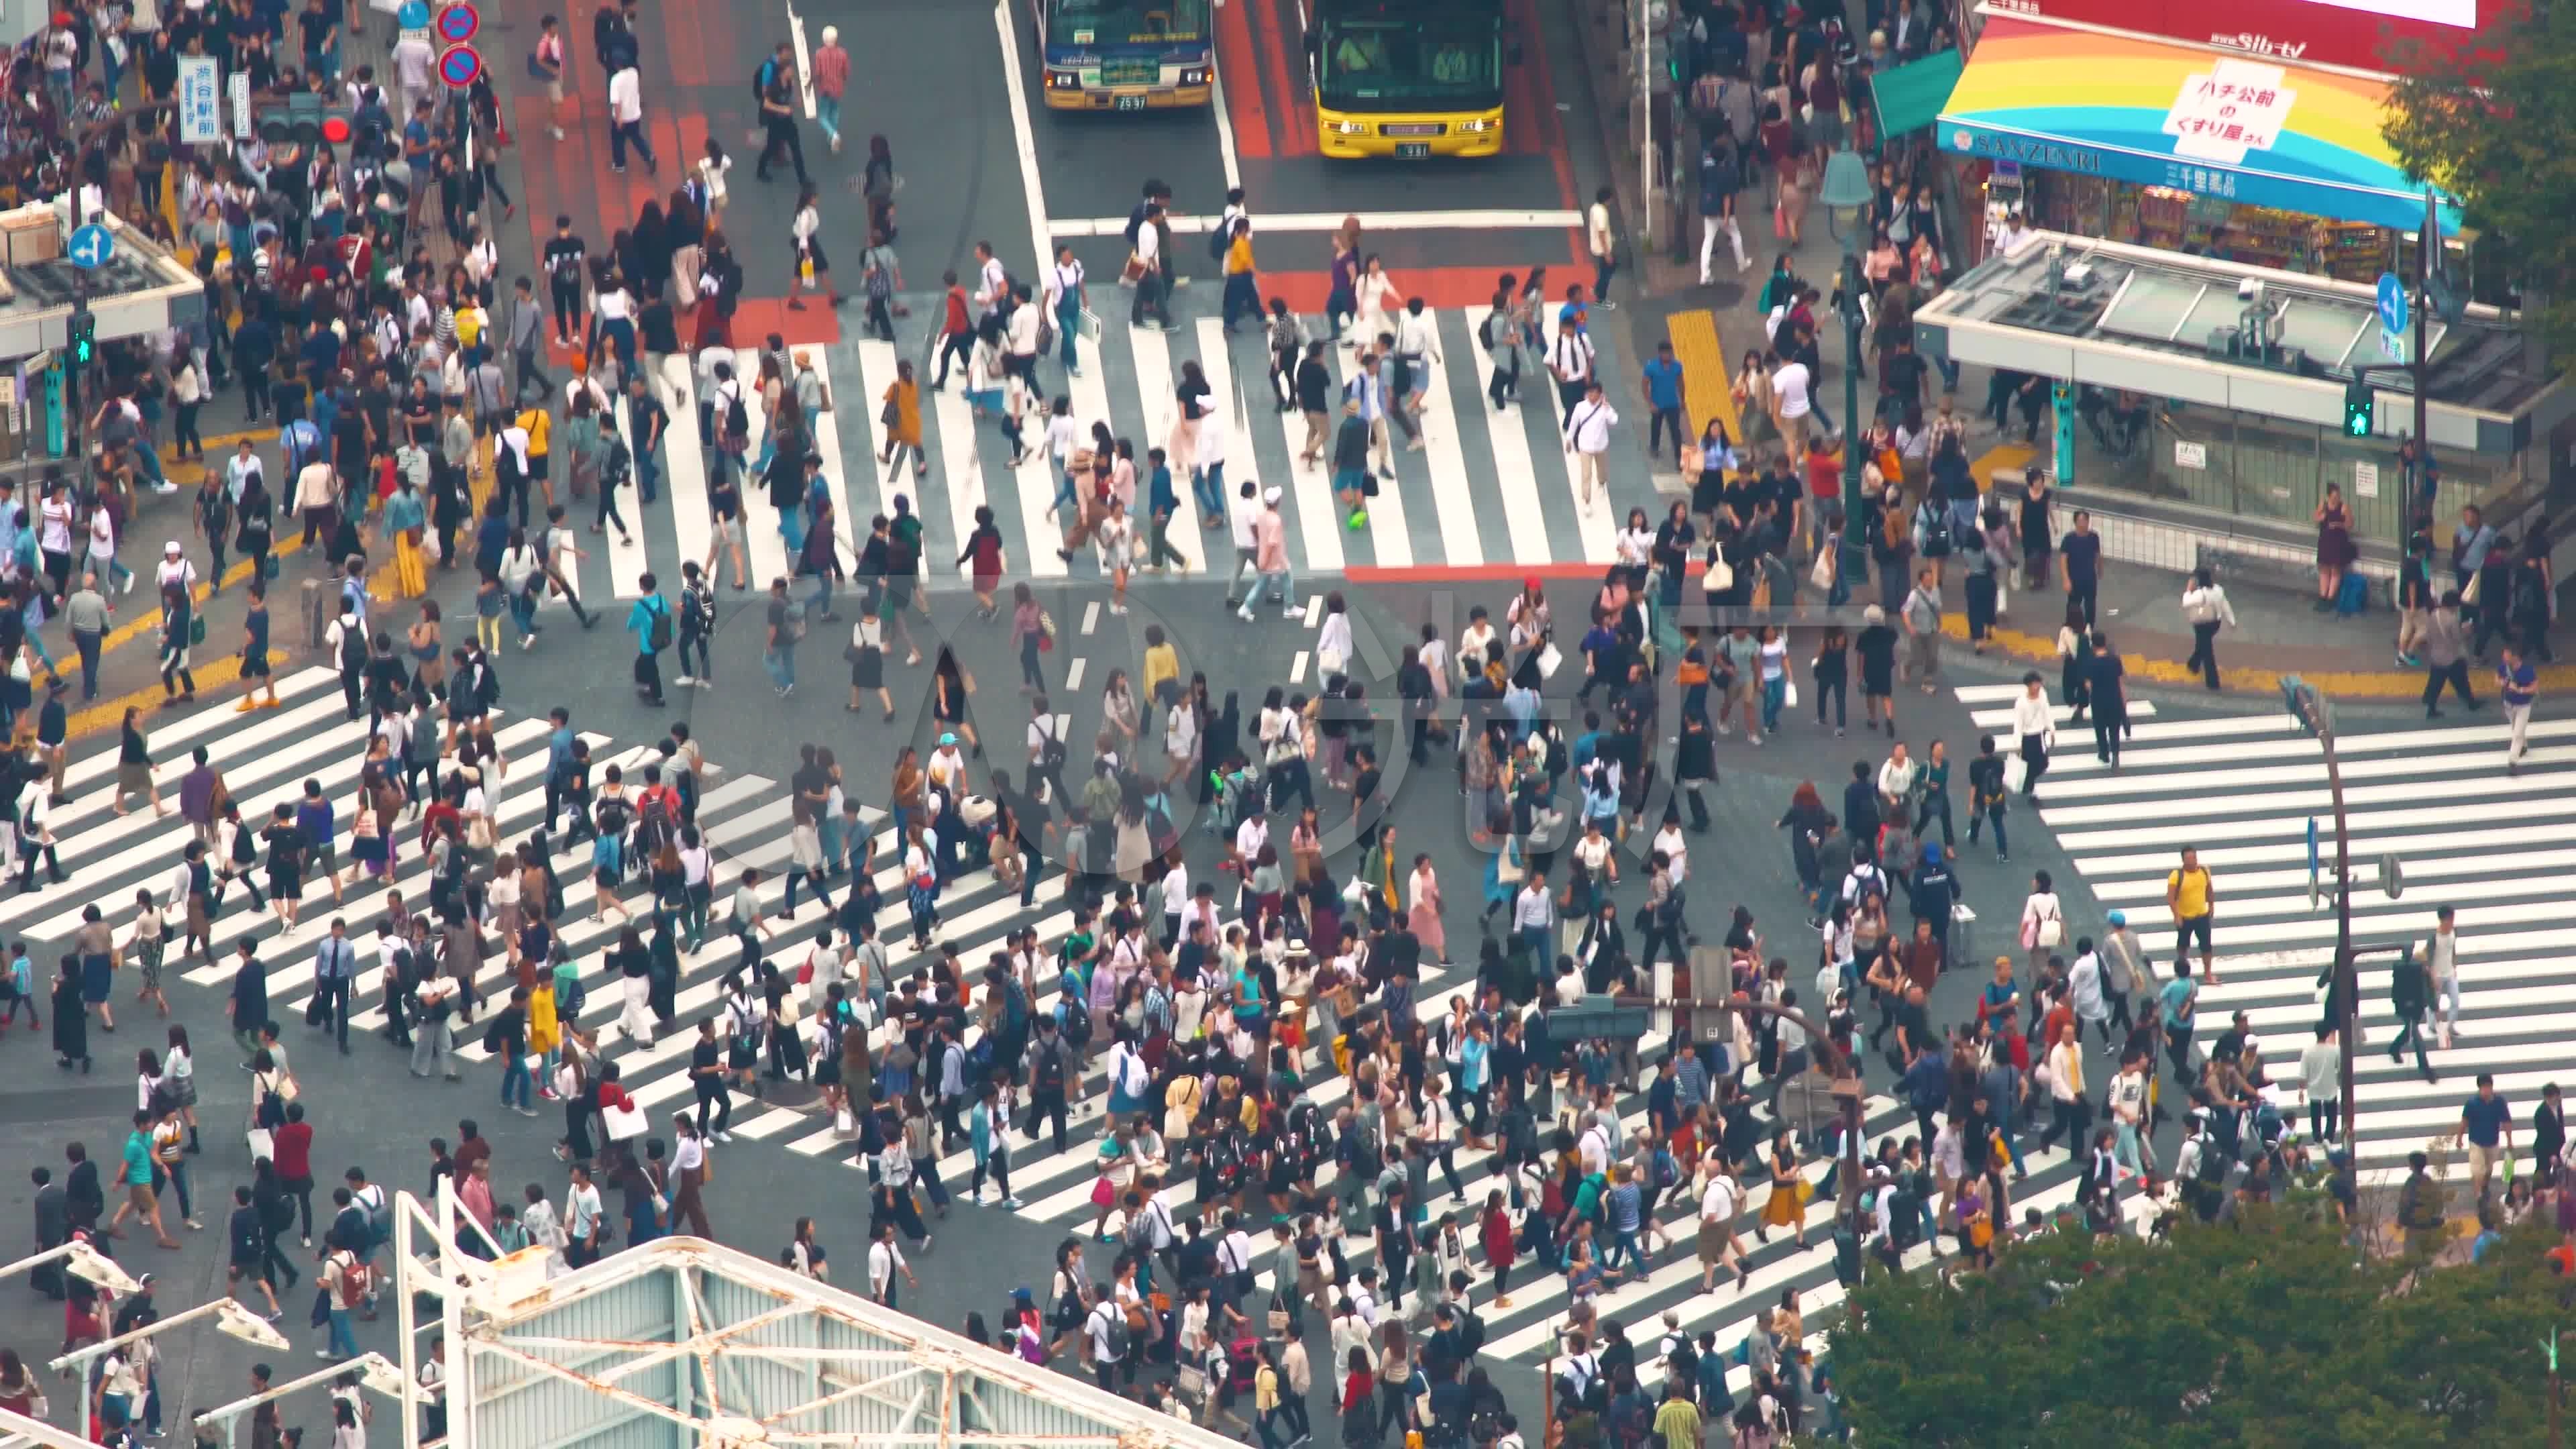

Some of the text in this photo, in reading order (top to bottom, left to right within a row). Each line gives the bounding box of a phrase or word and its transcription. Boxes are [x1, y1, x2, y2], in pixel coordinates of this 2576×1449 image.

[2197, 80, 2276, 108] ハチ公前
[2219, 105, 2237, 118] の
[2176, 116, 2265, 146] くすり屋さん
[1978, 133, 2100, 172] SANZENRI
[2165, 162, 2235, 198] 三千里薬品
